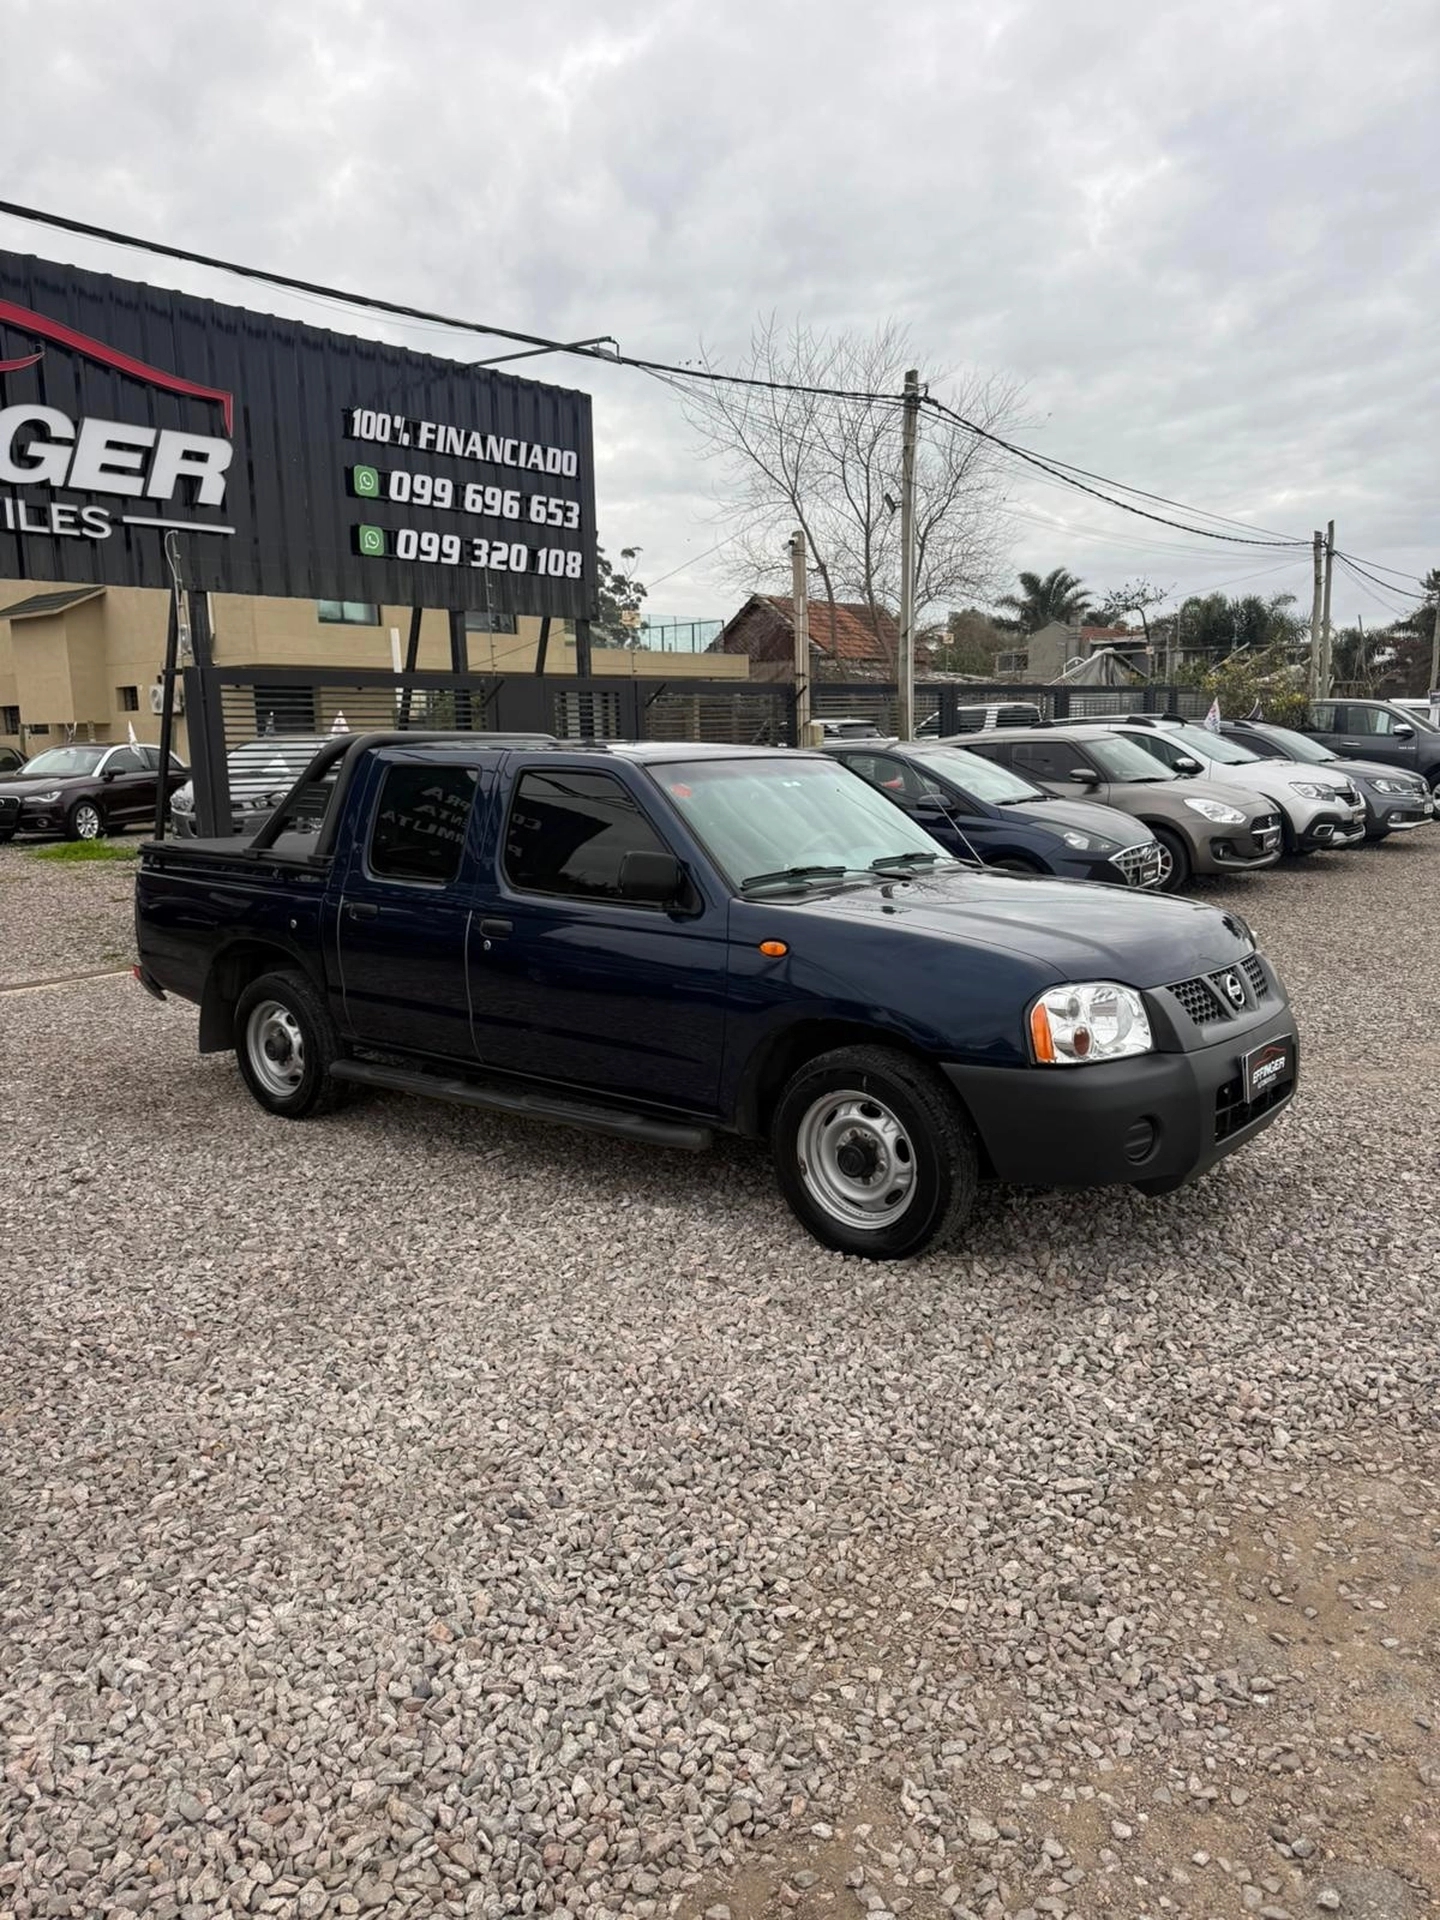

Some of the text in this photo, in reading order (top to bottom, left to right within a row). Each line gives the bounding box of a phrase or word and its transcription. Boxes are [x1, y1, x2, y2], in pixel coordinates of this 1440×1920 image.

[0, 403, 233, 506] GER
[352, 408, 578, 477] 100% FINANCIADO
[4, 497, 112, 539] ILES
[389, 470, 580, 529] 099 696 653
[396, 529, 582, 579] 099 320 108
